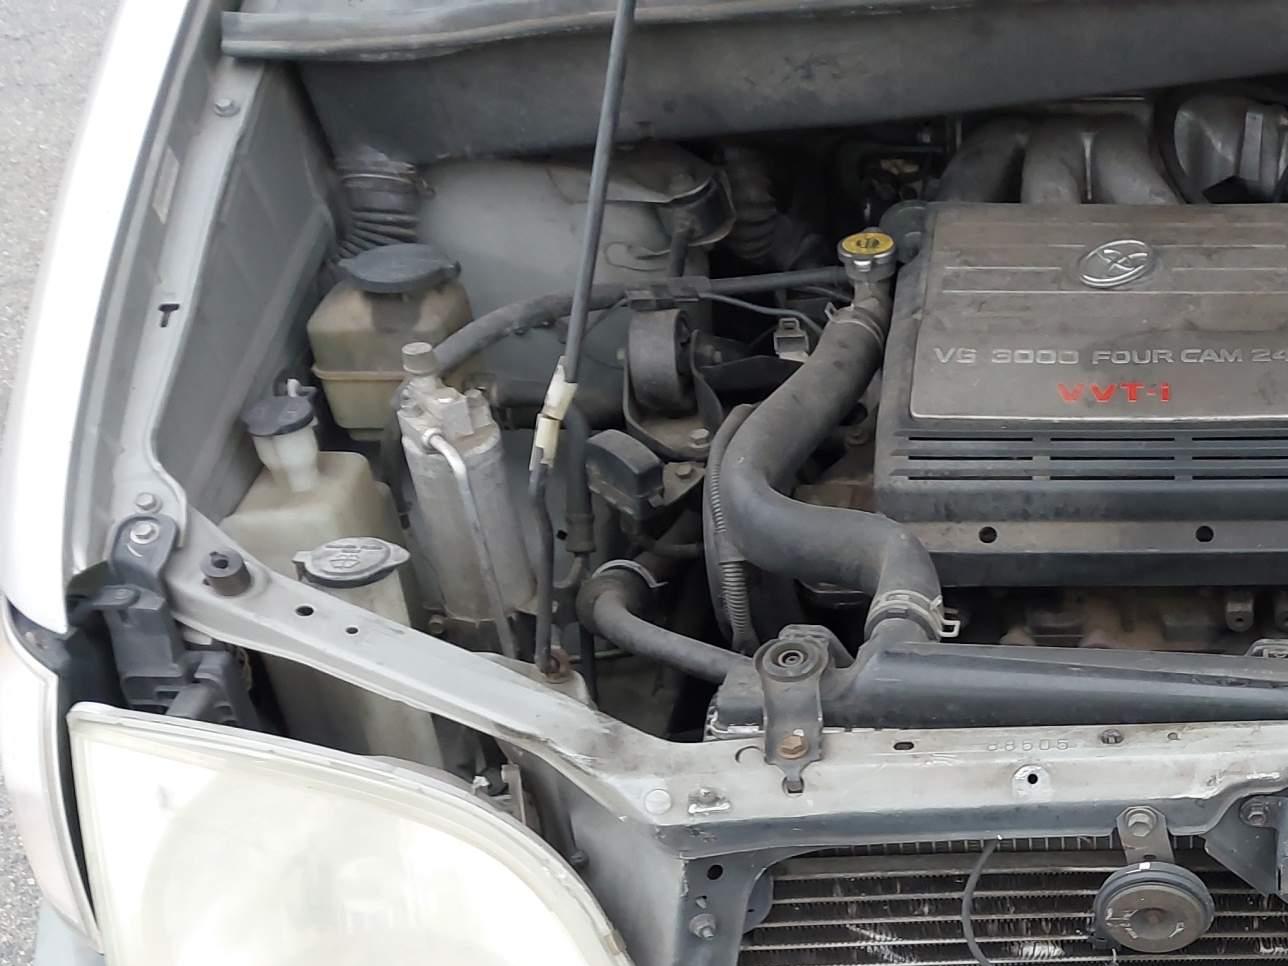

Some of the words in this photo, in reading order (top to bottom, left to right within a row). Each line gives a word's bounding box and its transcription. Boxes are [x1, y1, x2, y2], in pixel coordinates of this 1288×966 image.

[934, 348, 977, 365] V6
[992, 348, 1079, 365] 3000
[1092, 349, 1174, 365] FOUR
[1181, 348, 1243, 363] CAM
